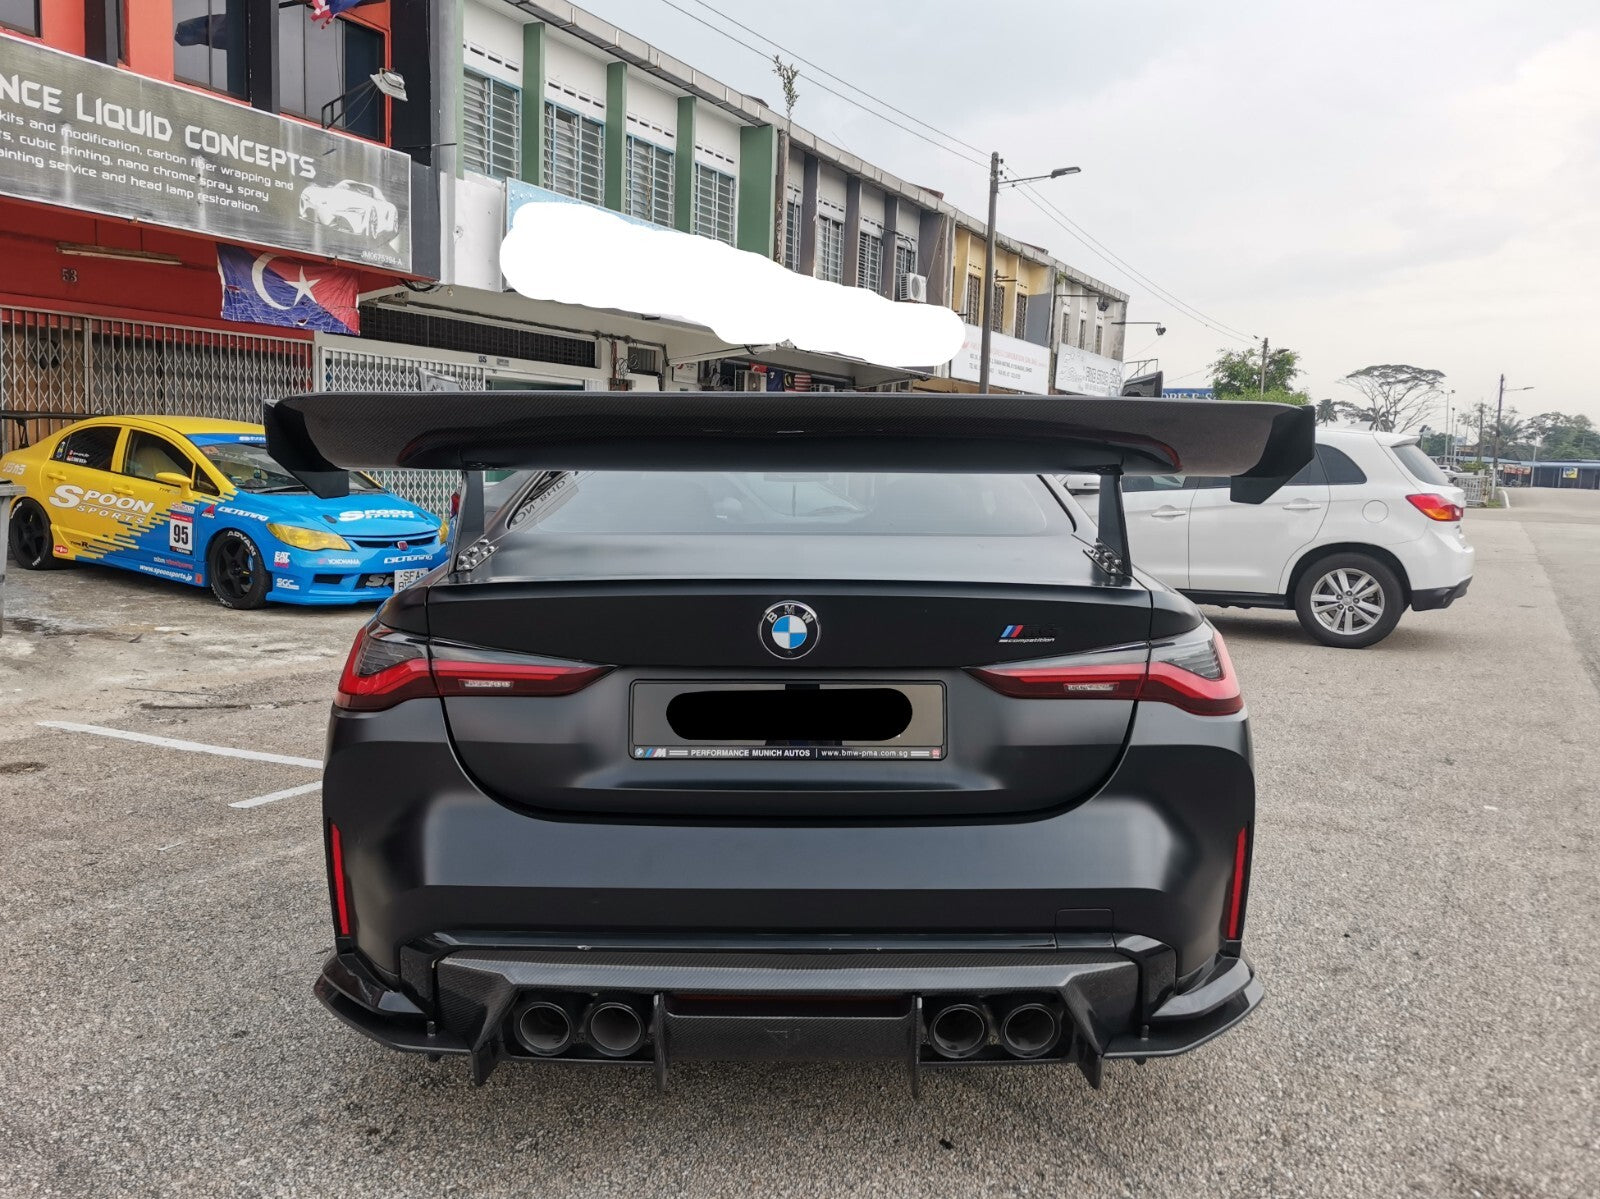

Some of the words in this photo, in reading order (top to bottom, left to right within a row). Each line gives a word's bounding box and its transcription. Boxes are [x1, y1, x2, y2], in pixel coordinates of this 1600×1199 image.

[0, 73, 63, 115] NCE
[76, 92, 173, 142] LIQUID
[185, 124, 317, 179] CONCEPTS
[0, 109, 24, 126] kits
[29, 118, 56, 133] and
[61, 126, 143, 155] modification,
[147, 148, 187, 165] carbon
[190, 156, 217, 172] fiber
[220, 166, 271, 187] wrapping
[274, 178, 294, 191] and
[19, 134, 57, 151] cubic
[61, 145, 114, 166] printing,
[117, 158, 149, 172] nano
[153, 165, 196, 183] chrome
[199, 176, 234, 194] spray,
[237, 185, 269, 202] spray
[49, 159, 97, 178] service
[102, 170, 126, 184] and
[130, 175, 162, 191] head
[166, 183, 194, 200] lamp
[197, 191, 260, 213] restoration.
[48, 484, 155, 513] SPOON
[77, 504, 146, 524] SPORTS
[172, 524, 190, 546] 95
[227, 530, 257, 557] ADVAN
[767, 604, 814, 624] BMW
[690, 749, 750, 757] PERFORMANCE
[751, 749, 782, 757] MUNICH
[783, 749, 811, 757] AUTOS
[821, 749, 909, 758] www.bmw-pma.com.sg
